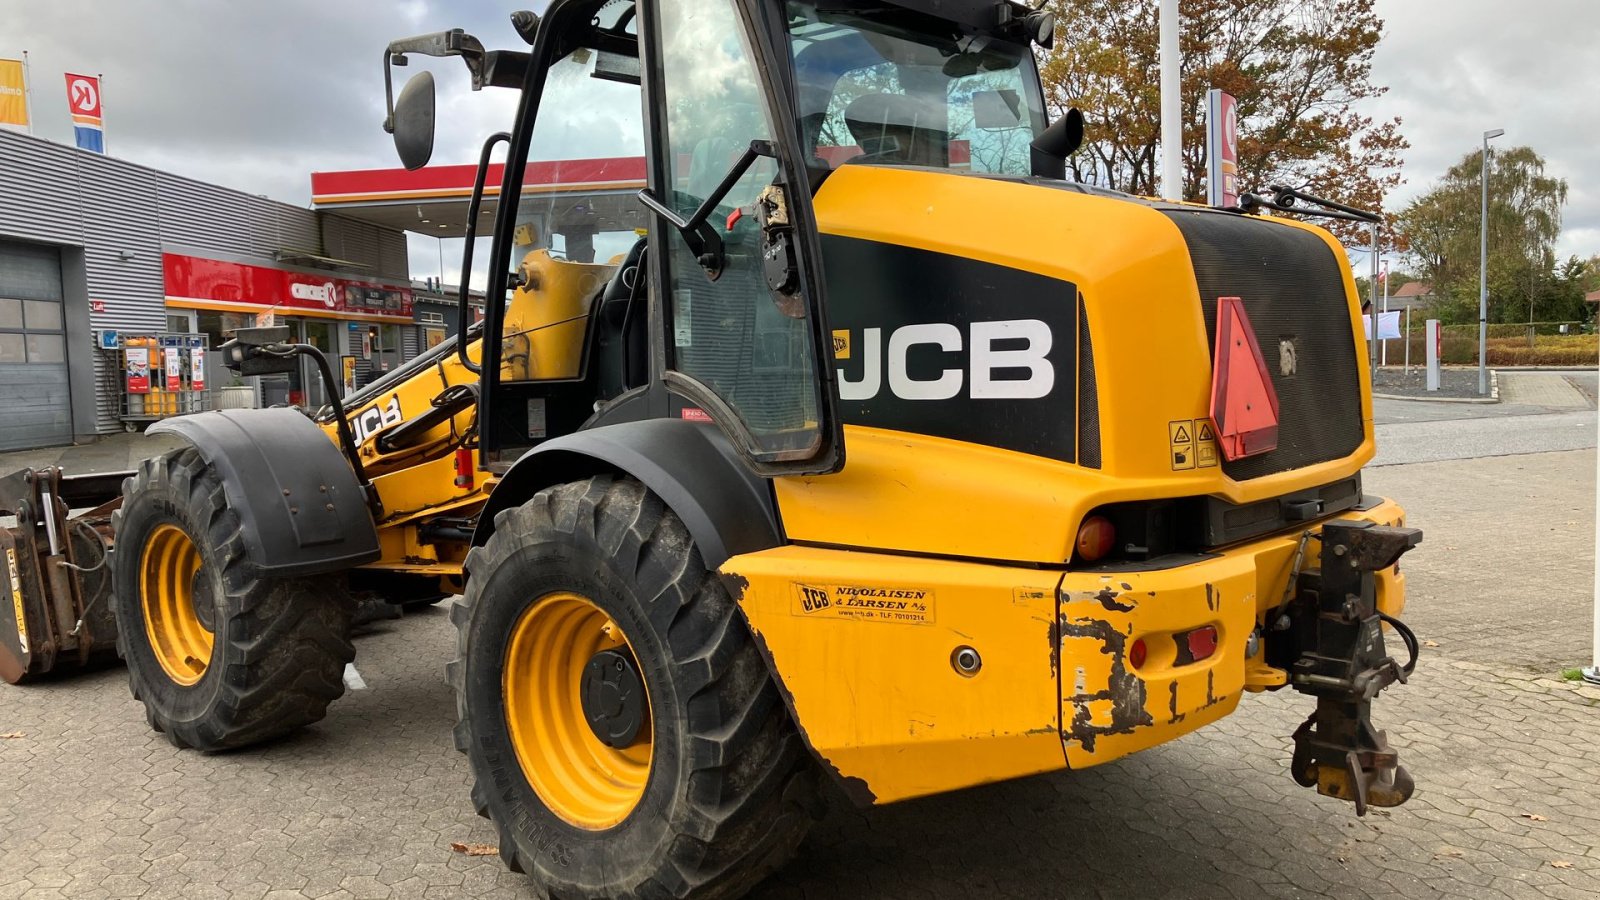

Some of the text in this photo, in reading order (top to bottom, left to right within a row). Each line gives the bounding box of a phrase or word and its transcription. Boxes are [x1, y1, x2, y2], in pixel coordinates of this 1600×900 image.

[837, 319, 1055, 400] JCB
[353, 397, 402, 448] JCB
[802, 587, 830, 611] JCB
[847, 598, 907, 609] LARSEN
[911, 602, 926, 611] A/S
[895, 613, 925, 621] 70101214
